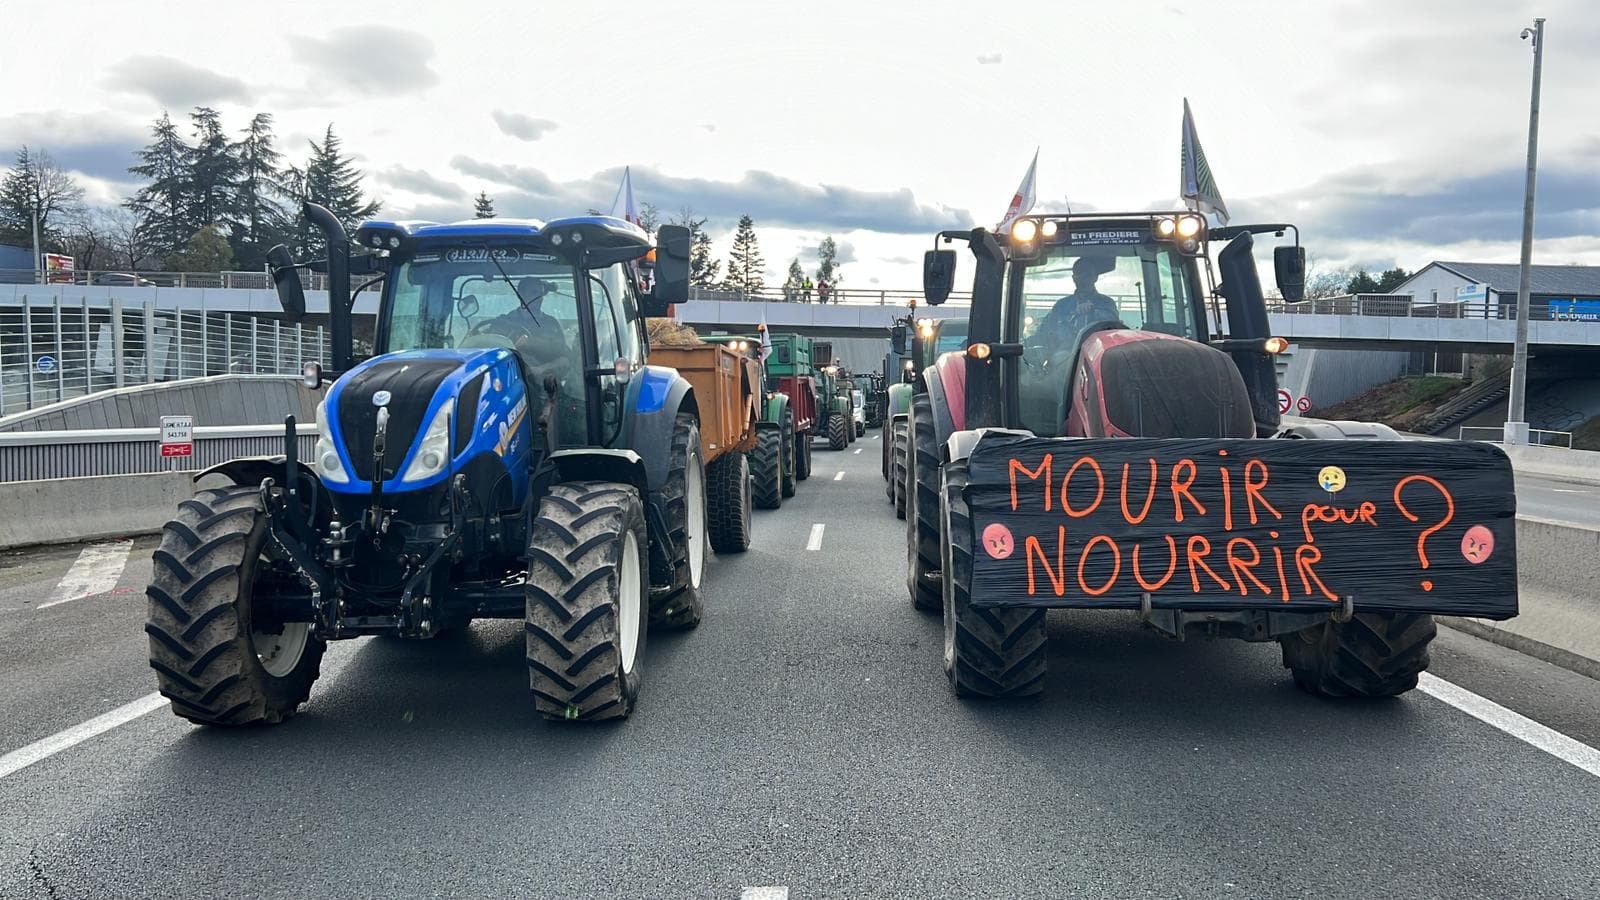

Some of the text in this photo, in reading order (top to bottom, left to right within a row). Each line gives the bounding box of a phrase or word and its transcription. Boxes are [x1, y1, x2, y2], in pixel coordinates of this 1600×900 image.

[1009, 449, 1282, 531] MOURIR
[1025, 475, 1456, 603] NOURRIR ?
